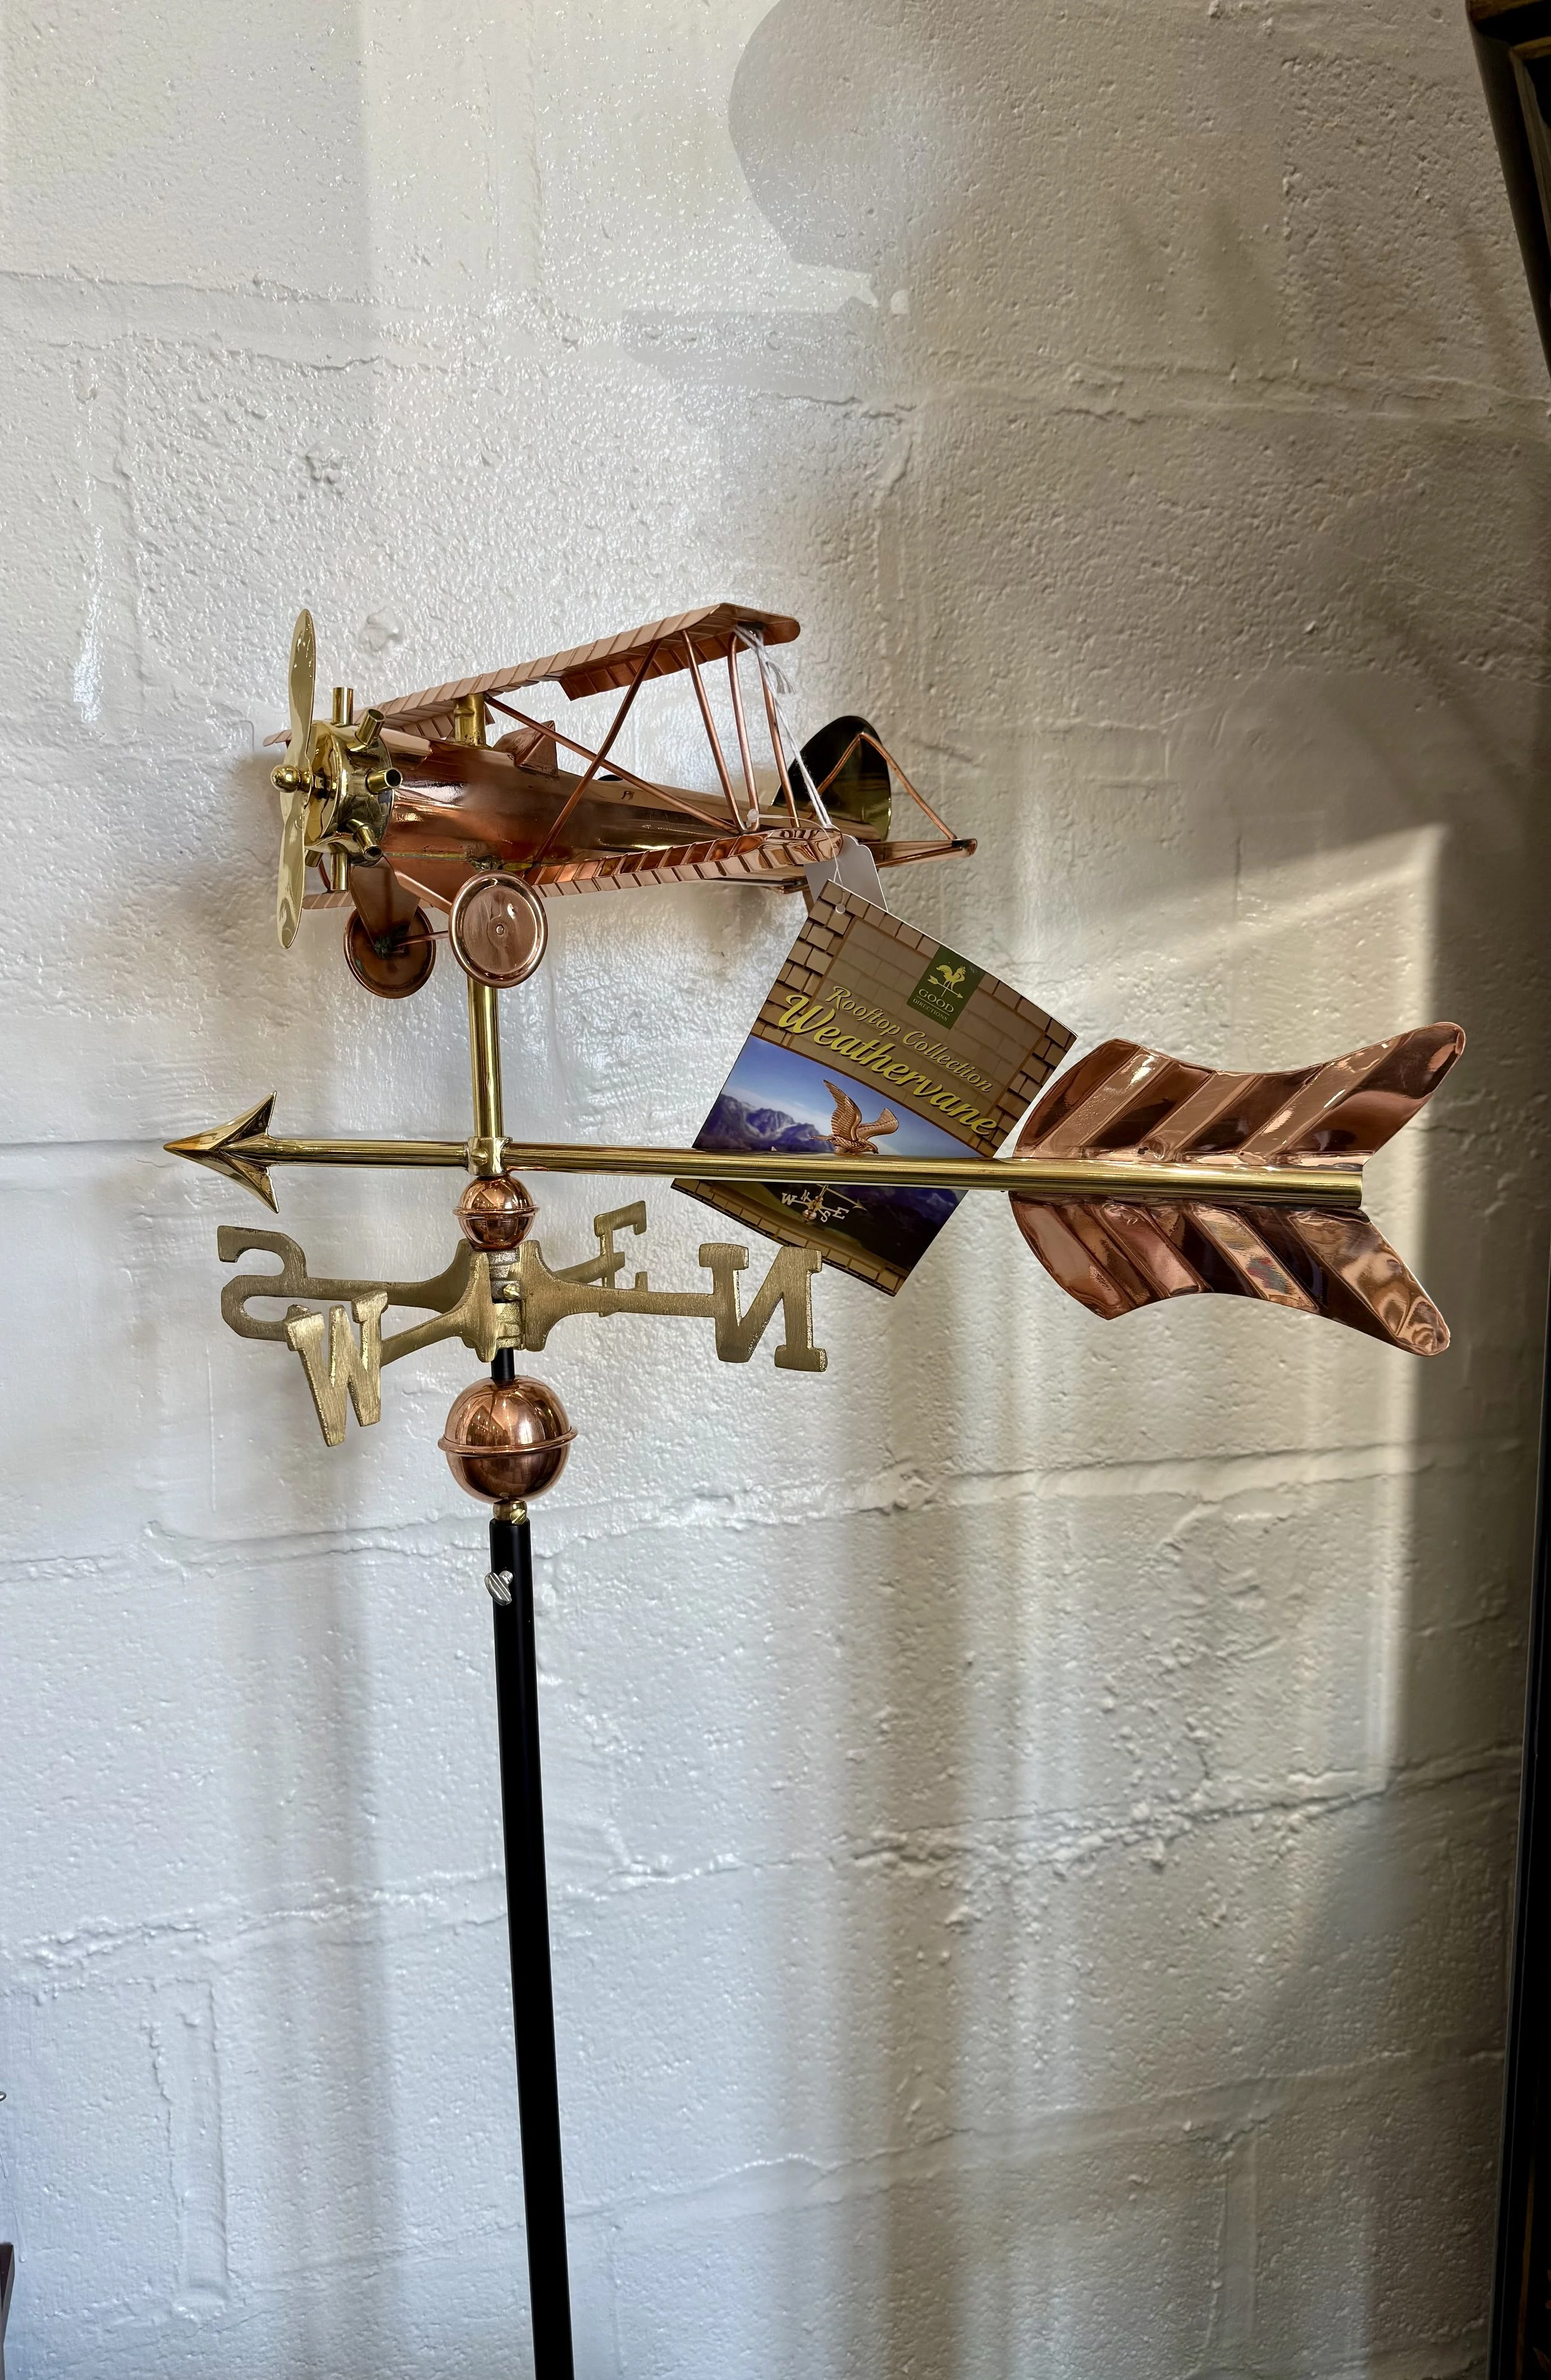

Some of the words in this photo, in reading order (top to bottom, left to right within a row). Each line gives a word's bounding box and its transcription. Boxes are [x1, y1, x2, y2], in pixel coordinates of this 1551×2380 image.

[913, 998, 947, 1021] DIRECTIONS
[919, 989, 954, 1013] GOOD
[825, 986, 901, 1036] Rooftop
[903, 1031, 993, 1093] Collection
[778, 994, 997, 1136] Weathervane
[782, 1192, 797, 1205] W
[832, 1206, 850, 1219] E
[284, 1289, 388, 1447] W
